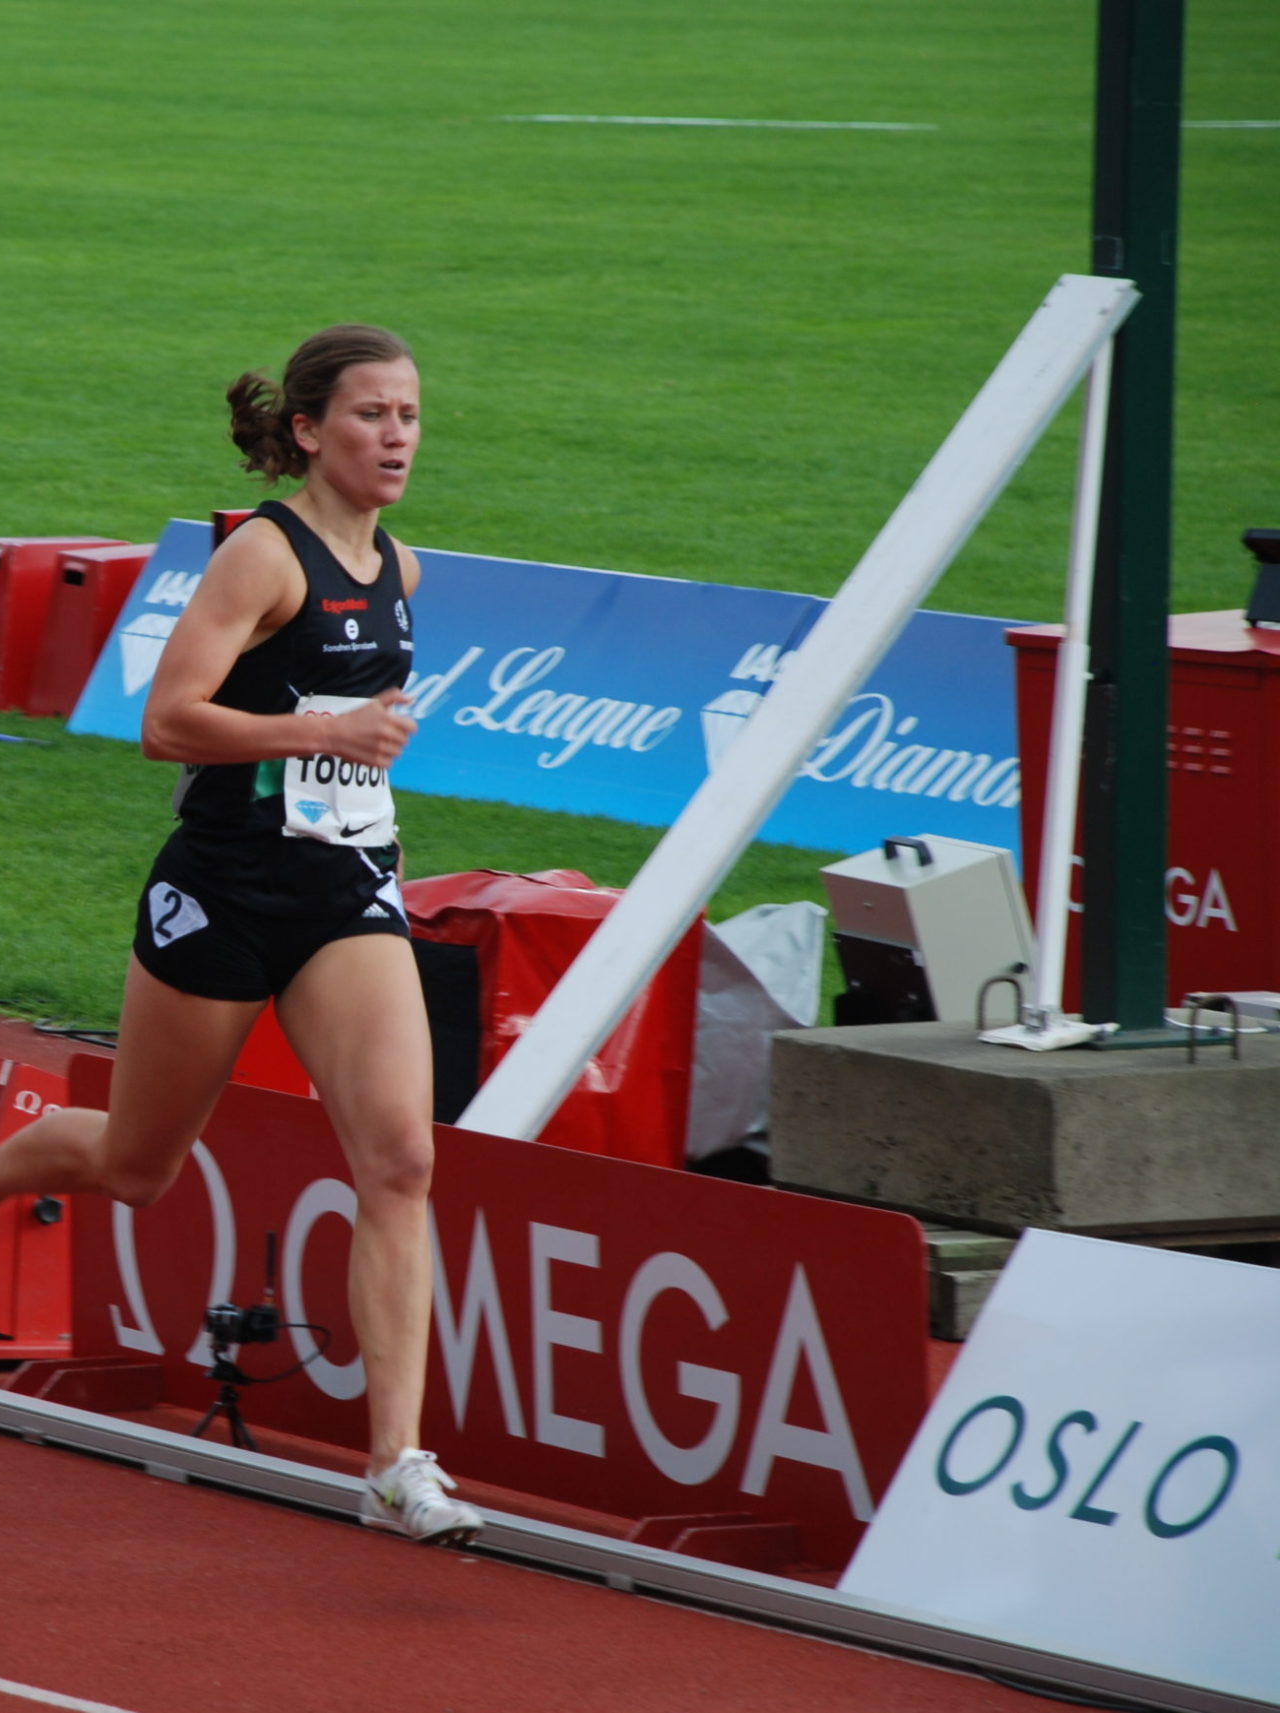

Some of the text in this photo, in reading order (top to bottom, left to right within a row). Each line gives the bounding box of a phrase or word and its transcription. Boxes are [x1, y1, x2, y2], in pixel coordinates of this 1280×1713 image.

[453, 646, 684, 770] League
[154, 890, 182, 939] 2
[282, 1178, 875, 1523] OMEGA
[935, 1394, 1240, 1540] OSLO
